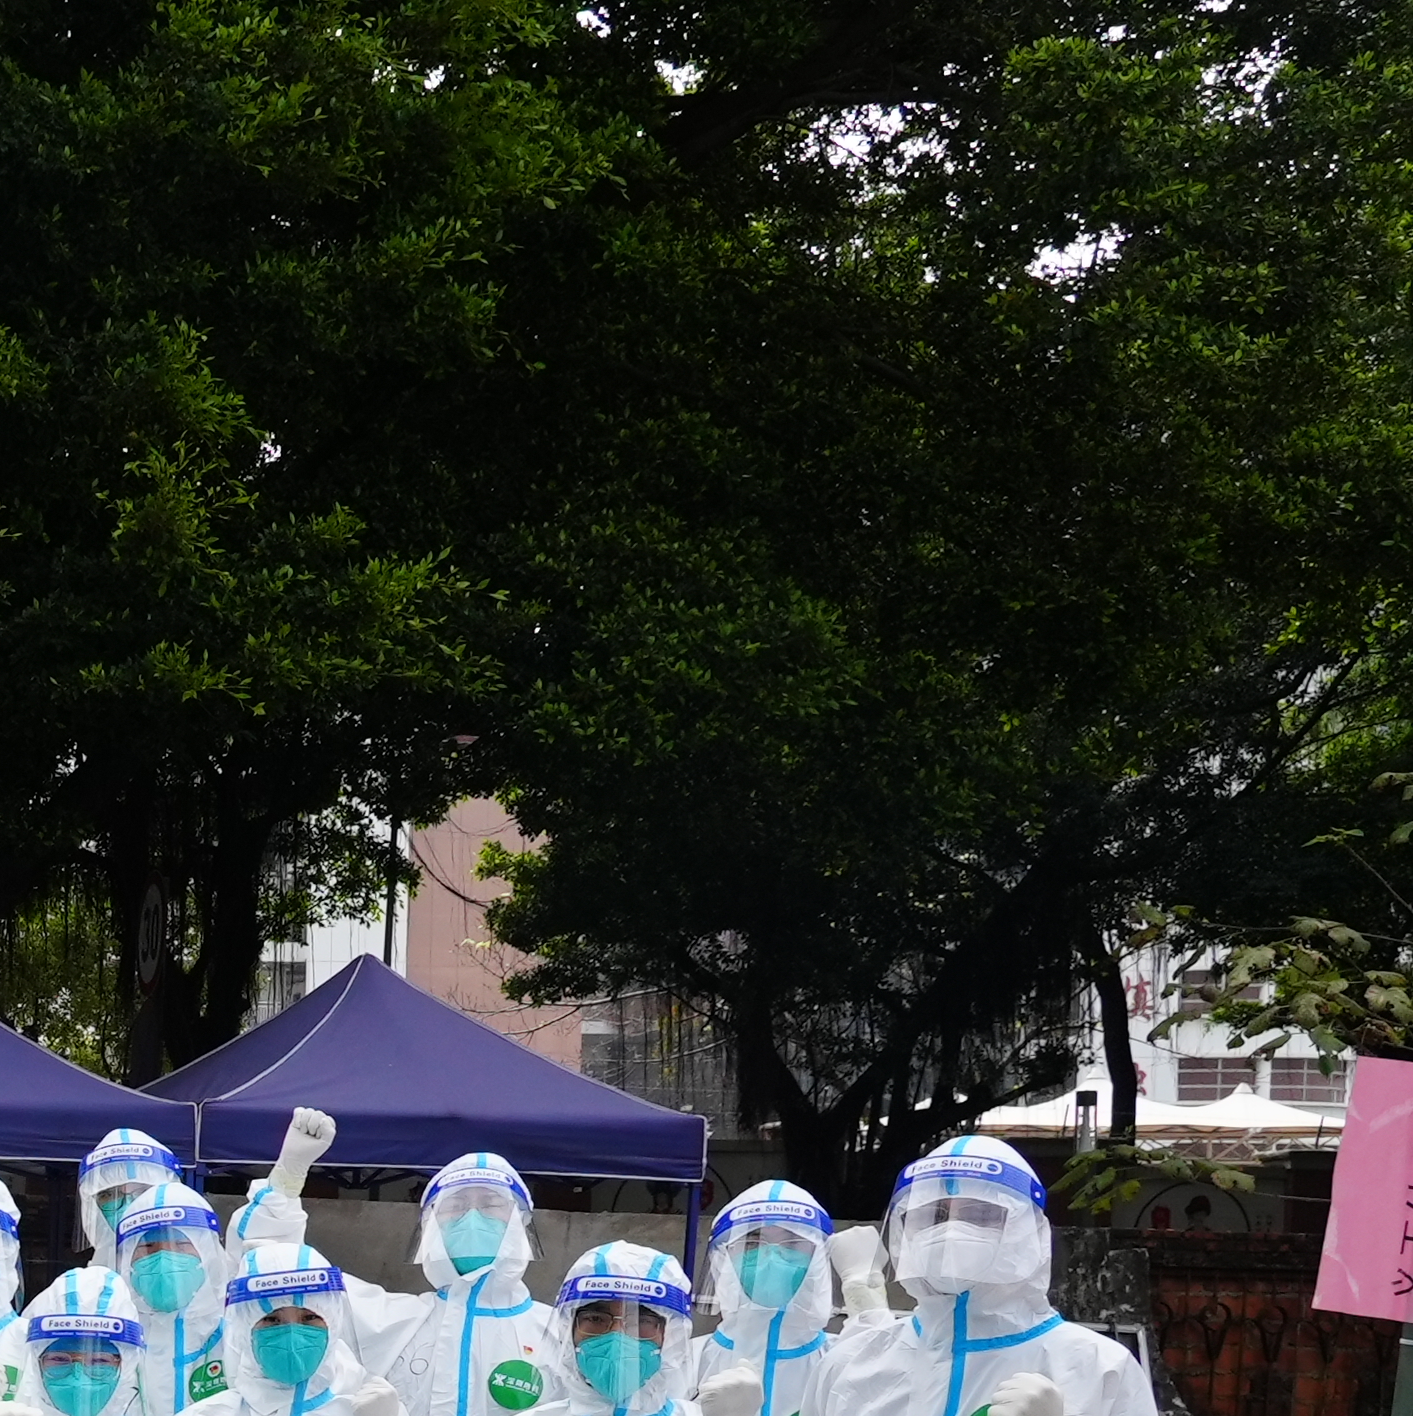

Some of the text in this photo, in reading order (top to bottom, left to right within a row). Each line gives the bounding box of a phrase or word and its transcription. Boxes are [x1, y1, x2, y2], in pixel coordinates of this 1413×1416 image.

[141, 904, 159, 962] 30
[90, 1145, 140, 1159] Face Shield
[911, 1159, 983, 1173] Face Shield
[444, 1169, 501, 1180] Face Shield
[736, 1203, 801, 1215] Face Shield
[122, 1210, 170, 1230] Face Shield
[255, 1274, 316, 1288] Face Shield
[585, 1279, 651, 1293] Face Shield
[48, 1318, 110, 1329] Face Shield
